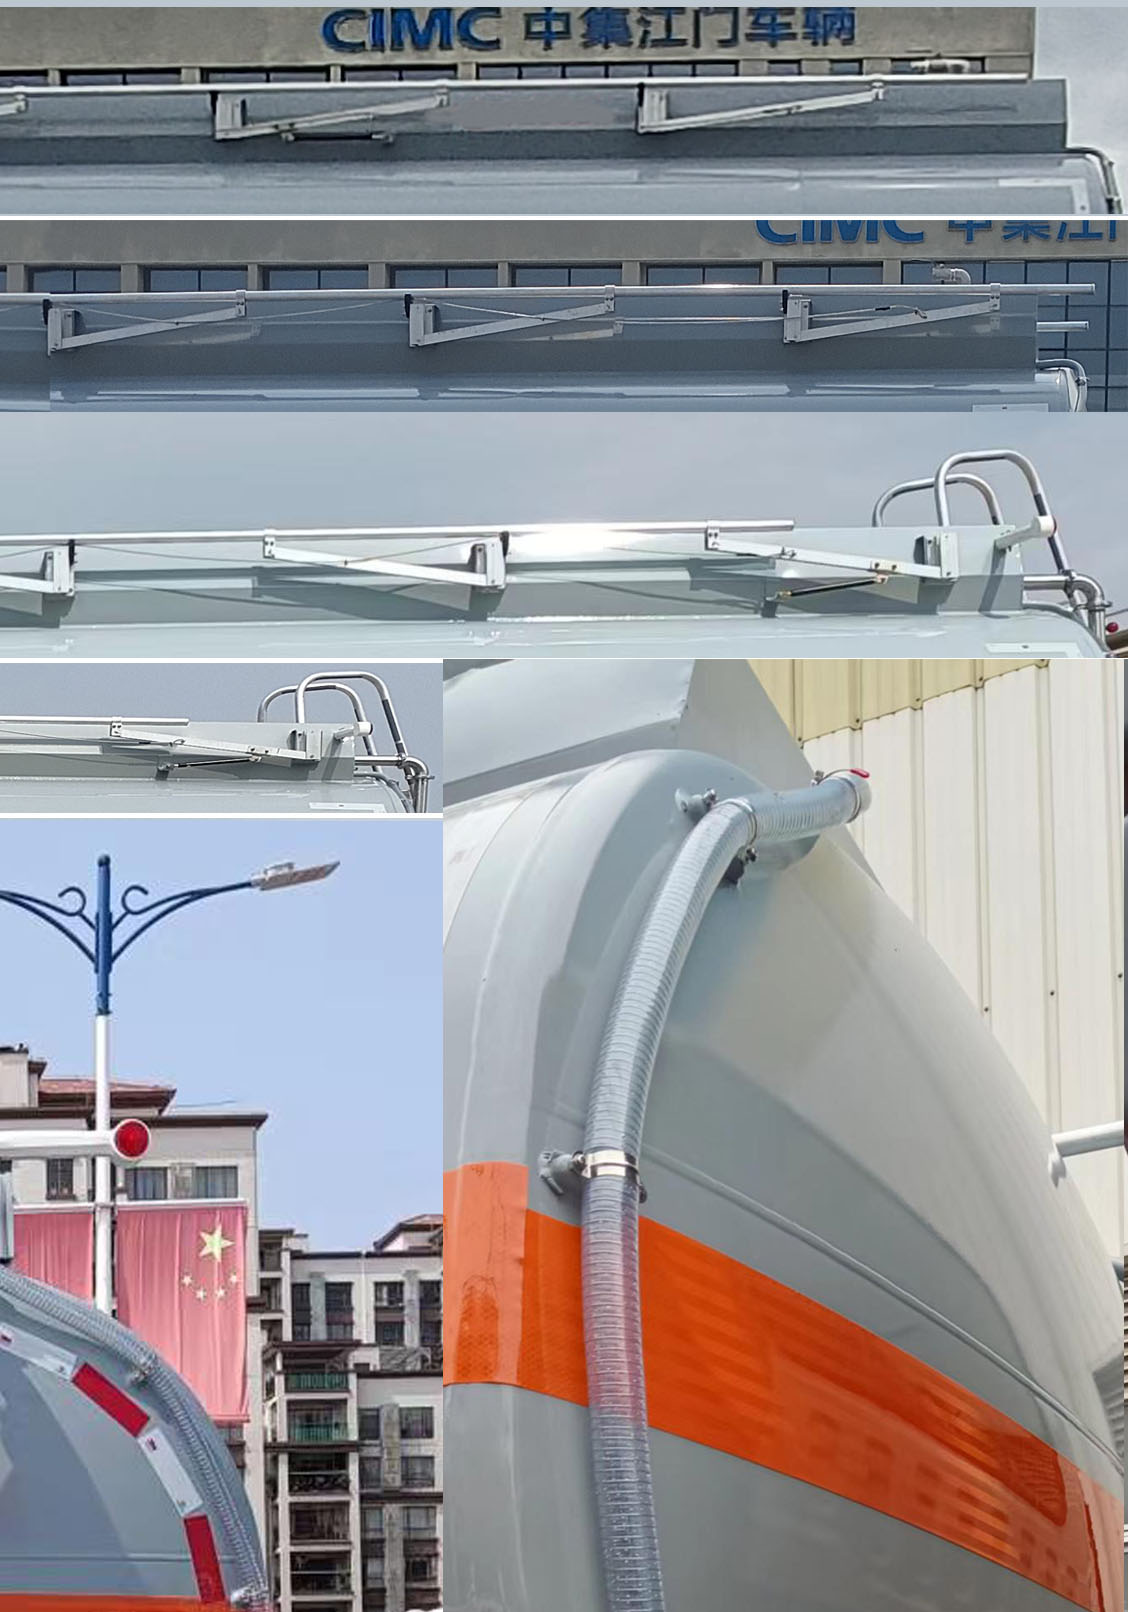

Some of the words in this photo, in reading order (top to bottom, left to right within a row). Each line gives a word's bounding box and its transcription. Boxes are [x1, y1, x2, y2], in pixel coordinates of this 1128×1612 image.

[322, 9, 501, 53] CIMC
[525, 8, 856, 50] 中集江门车辆
